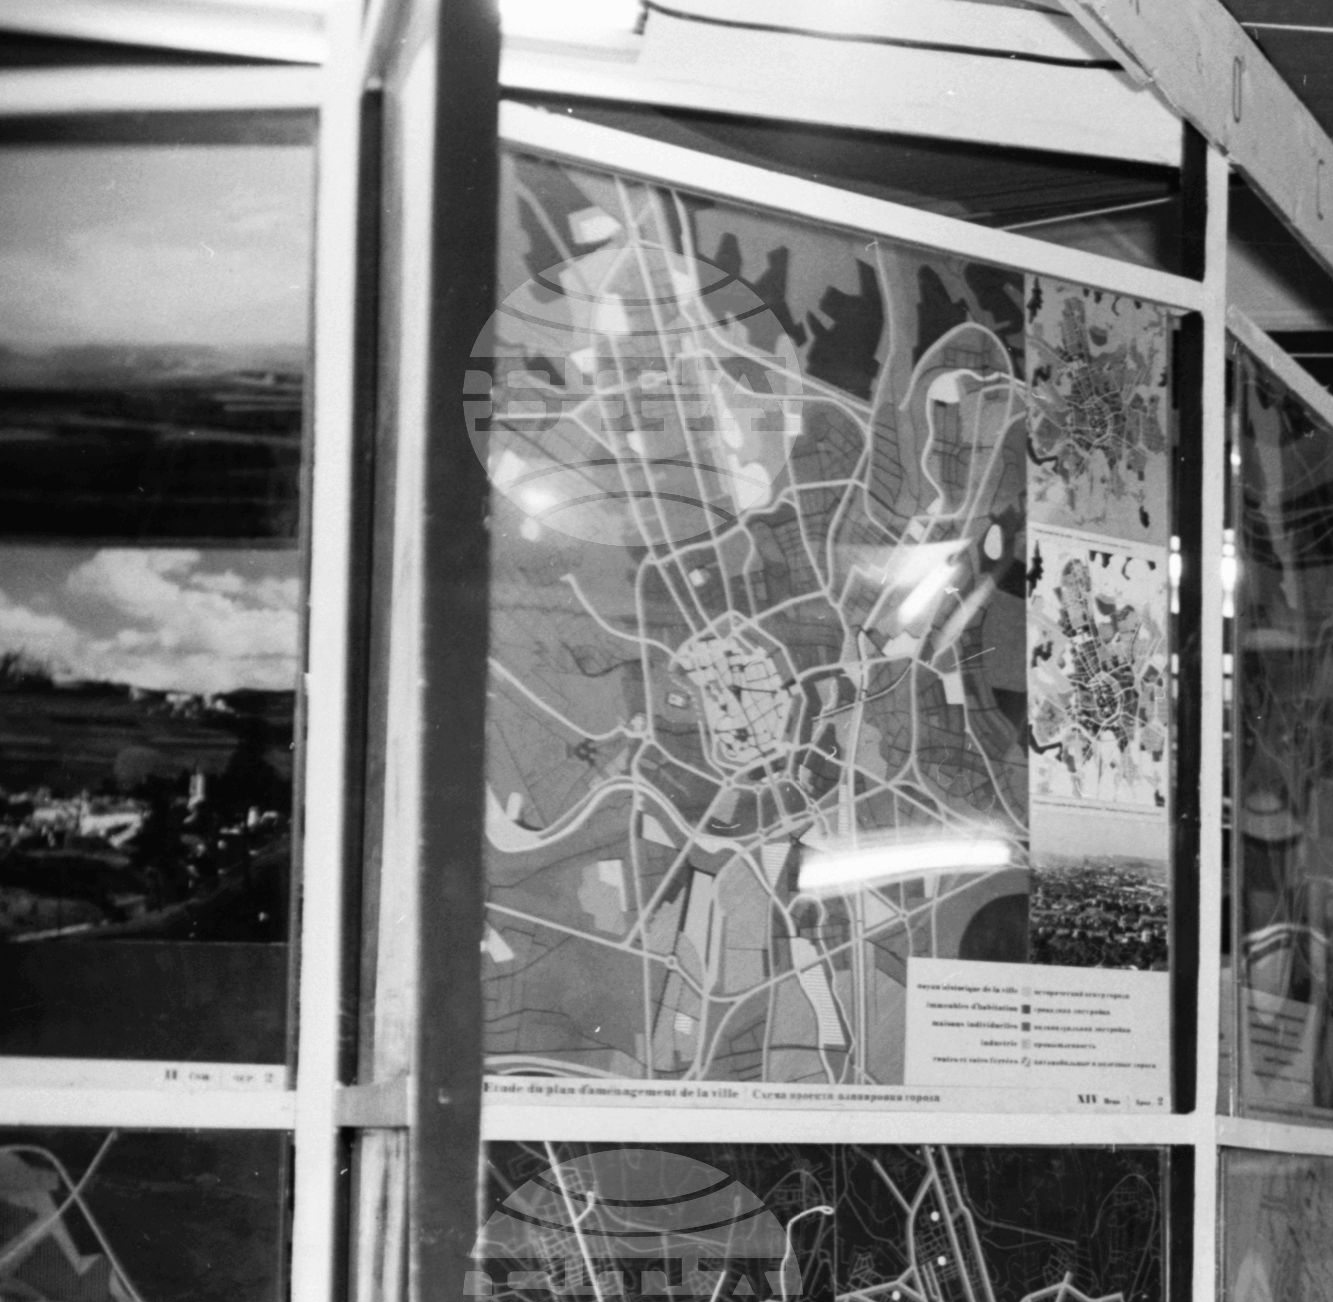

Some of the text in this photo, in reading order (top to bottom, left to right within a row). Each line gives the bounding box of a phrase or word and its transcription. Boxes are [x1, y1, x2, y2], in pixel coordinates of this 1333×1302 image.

[528, 1084, 543, 1093] du
[547, 1084, 575, 1096] plan
[680, 1088, 693, 1097] de
[697, 1088, 709, 1097] la
[712, 1088, 739, 1098] ville
